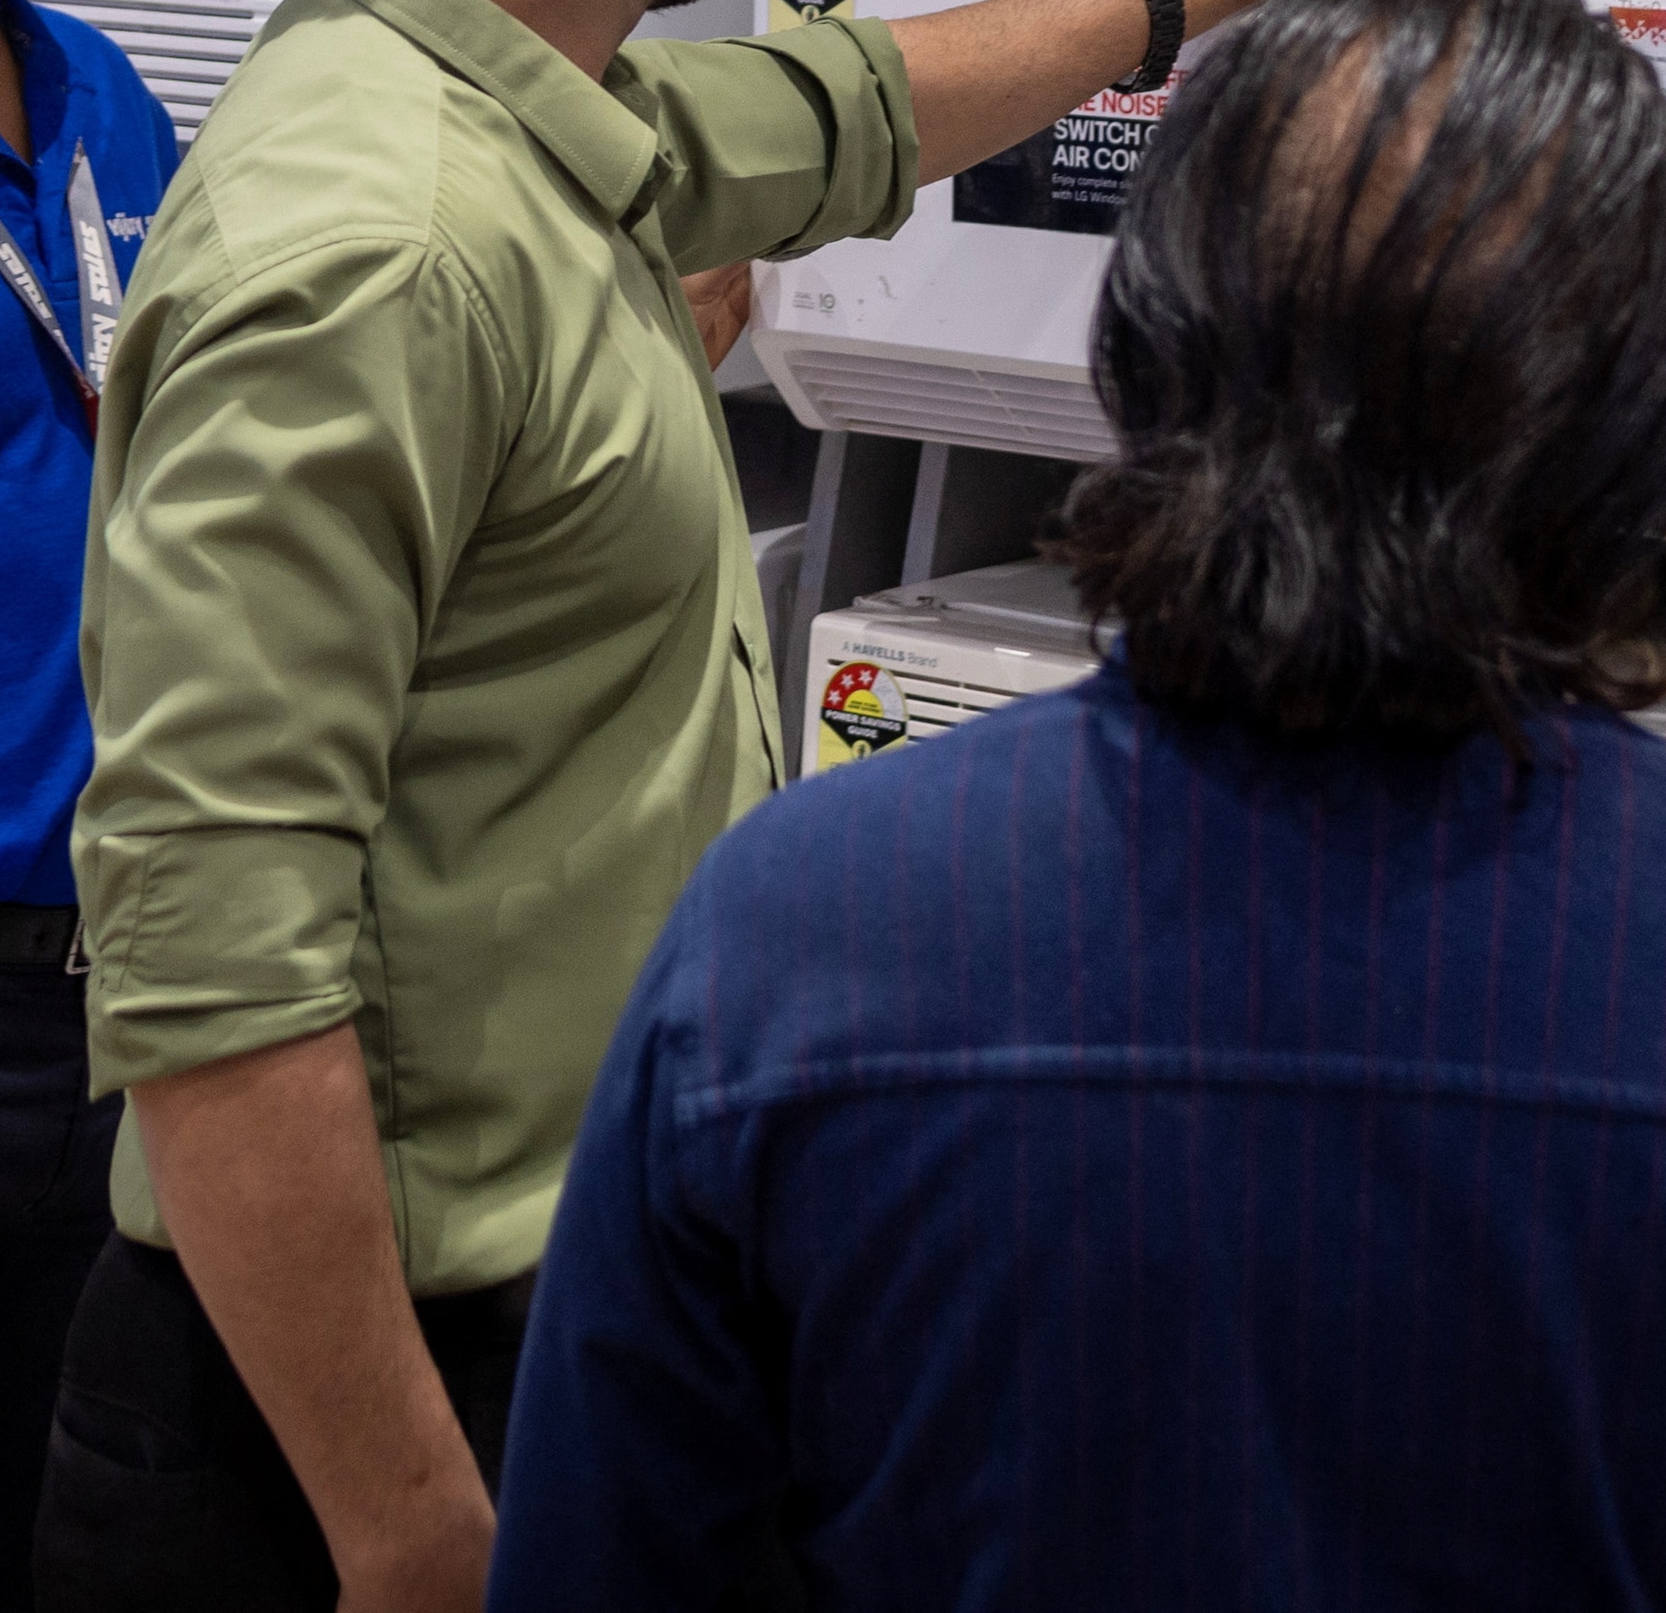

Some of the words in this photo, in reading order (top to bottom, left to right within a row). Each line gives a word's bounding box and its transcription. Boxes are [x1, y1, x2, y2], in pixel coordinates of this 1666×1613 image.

[1053, 117, 1140, 145] SWITCH
[1052, 144, 1089, 169] AIR
[1052, 173, 1076, 187] Enjoy
[1077, 175, 1118, 189] complete
[1052, 189, 1074, 201] with
[1075, 190, 1088, 202] LG
[852, 642, 905, 662] HAVELLS
[908, 651, 939, 669] Brand
[825, 709, 859, 723] POWER
[860, 715, 902, 732] SAVINGS
[847, 725, 879, 740] GUIDE
